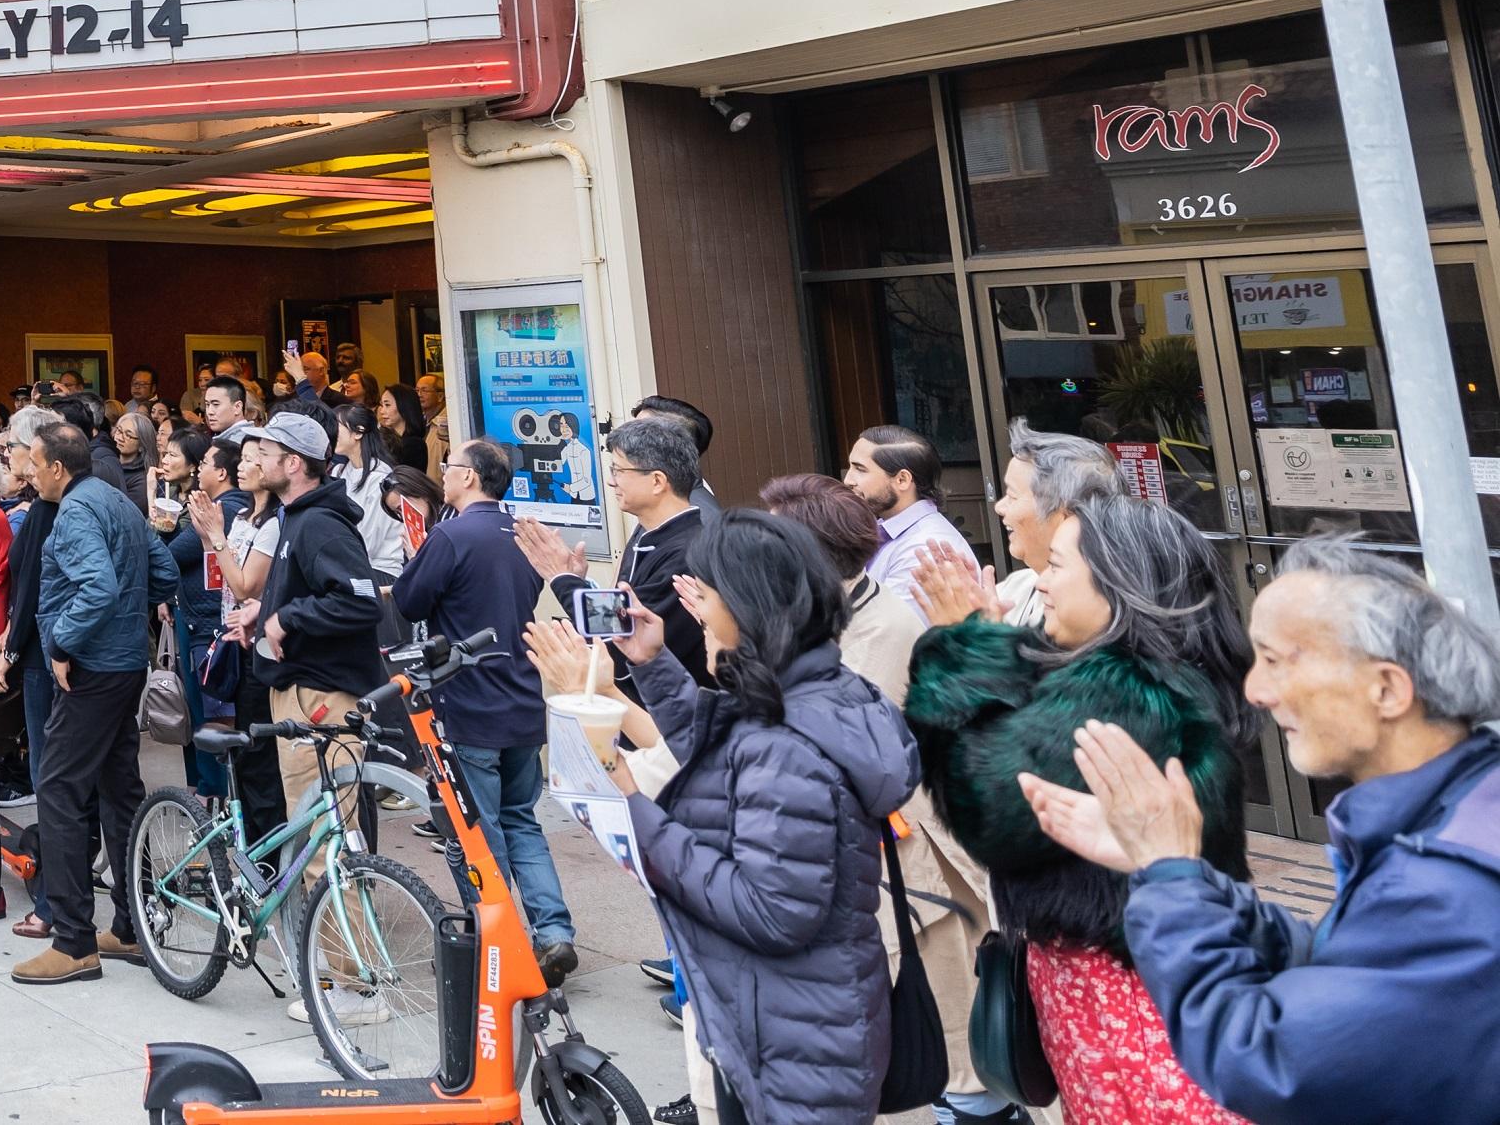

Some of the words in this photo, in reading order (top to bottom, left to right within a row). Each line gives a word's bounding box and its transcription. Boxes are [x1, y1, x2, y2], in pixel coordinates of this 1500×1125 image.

[1092, 82, 1281, 174] rams
[1157, 192, 1238, 222] 3626
[1116, 445, 1147, 453] BUSINESS
[478, 1003, 497, 1061] SPIN
[320, 1088, 380, 1098] SPIN
